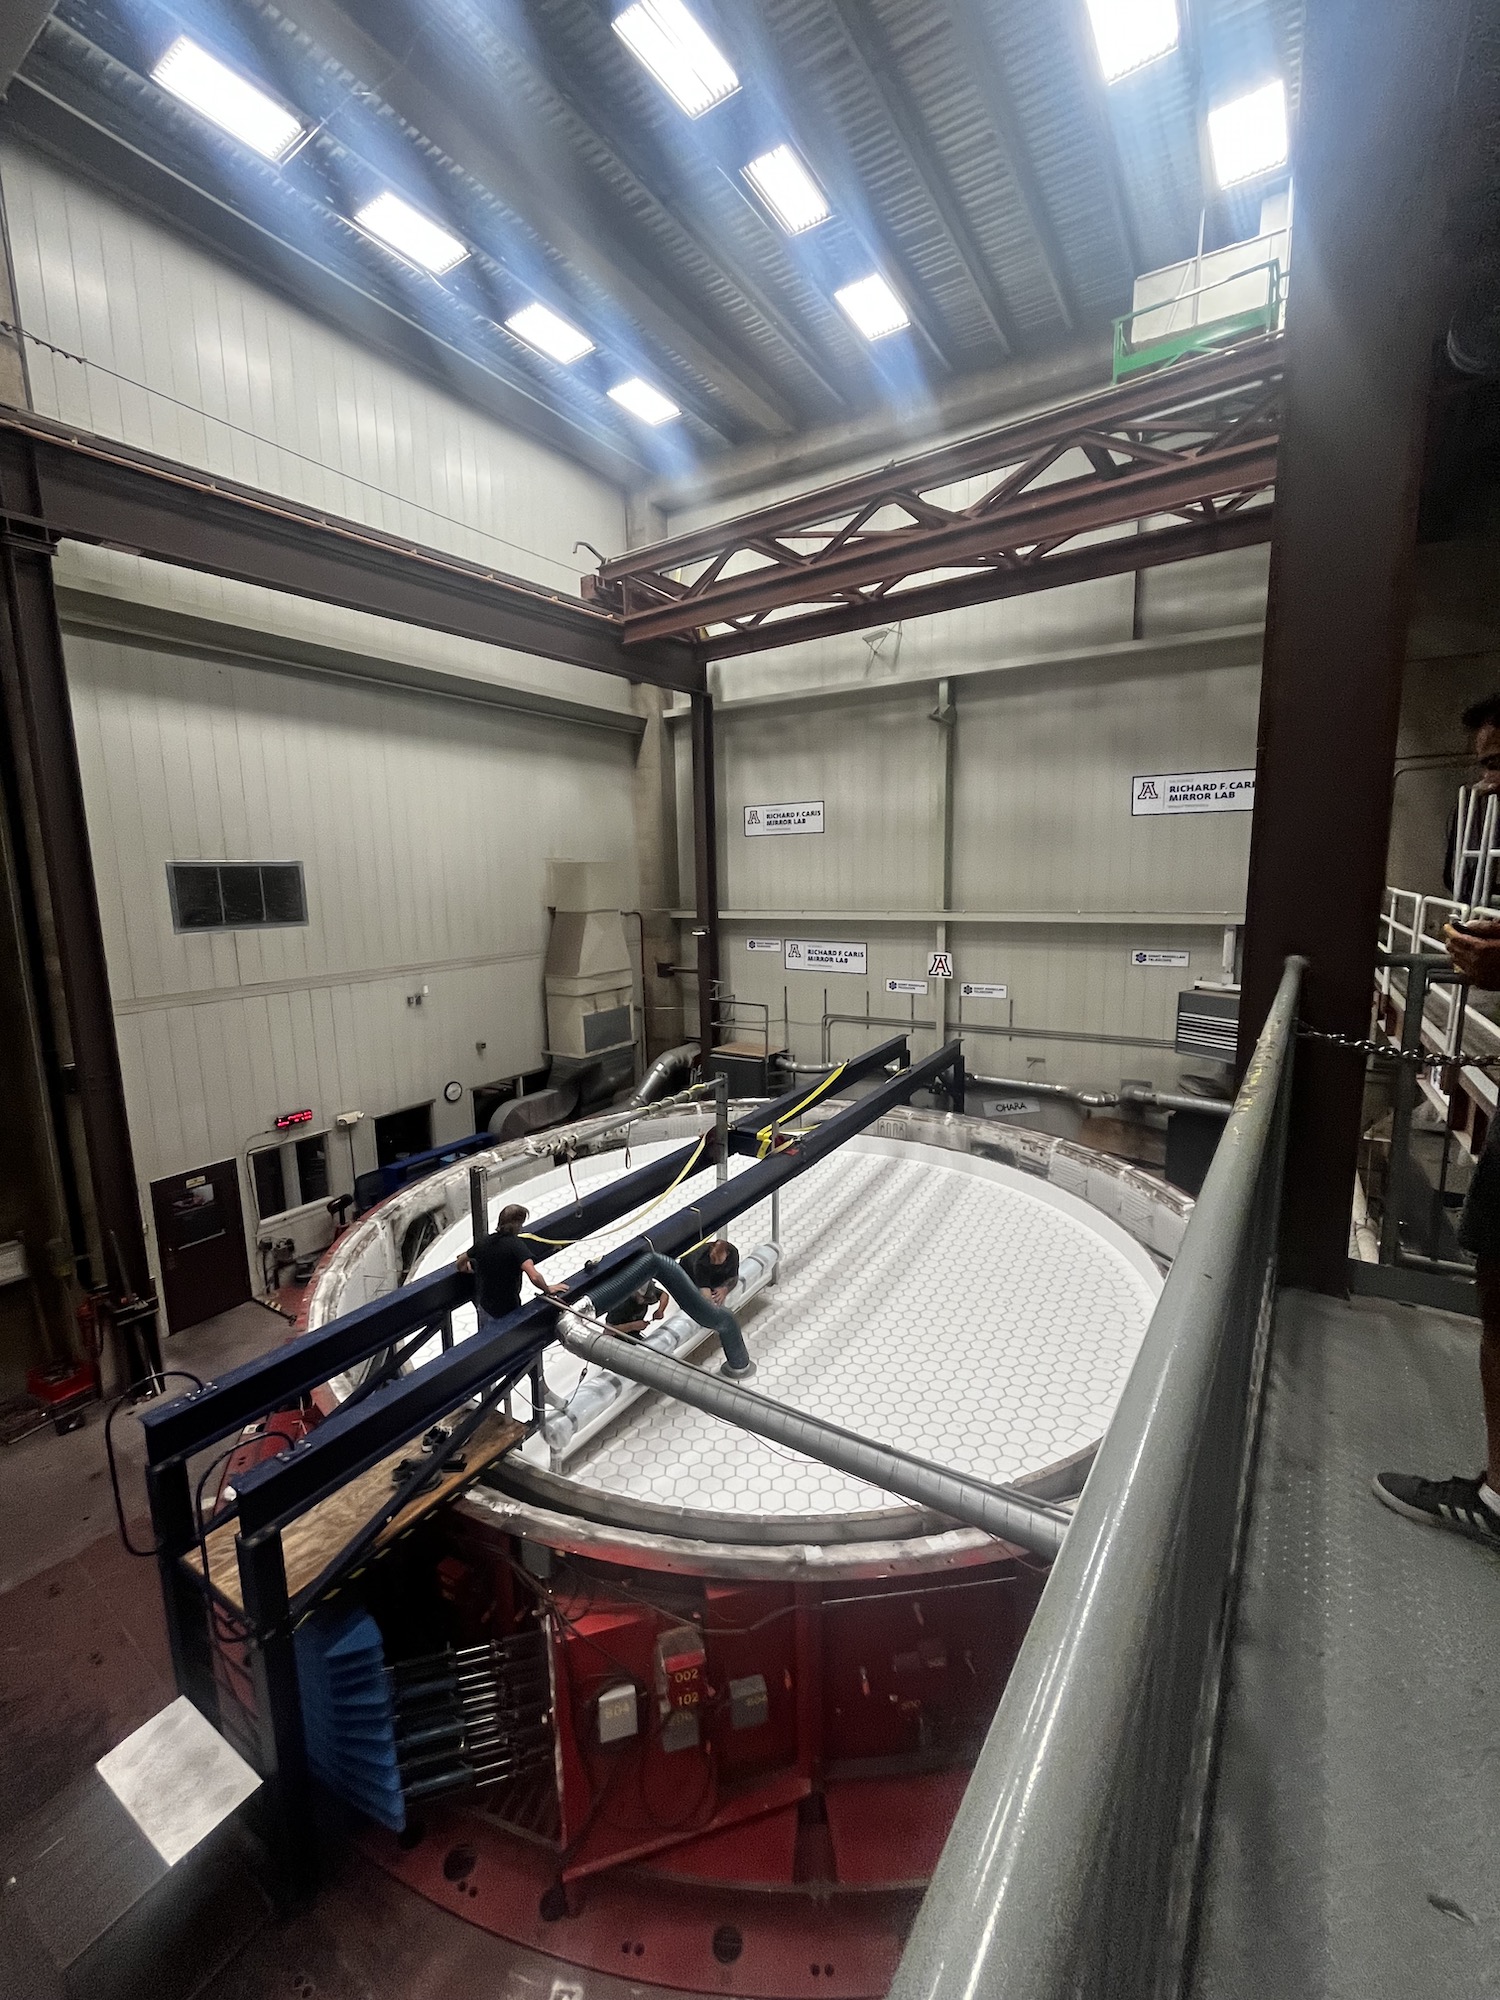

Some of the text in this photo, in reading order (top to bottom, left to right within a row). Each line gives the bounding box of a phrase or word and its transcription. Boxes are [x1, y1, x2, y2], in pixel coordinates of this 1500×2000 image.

[1169, 781, 1255, 793] RICHARD F. CARI
[1169, 791, 1236, 801] MIRROR LAB
[766, 811, 795, 819] RICHARD
[928, 954, 952, 977] A
[675, 1668, 699, 1683] 002
[678, 1691, 699, 1706] 102
